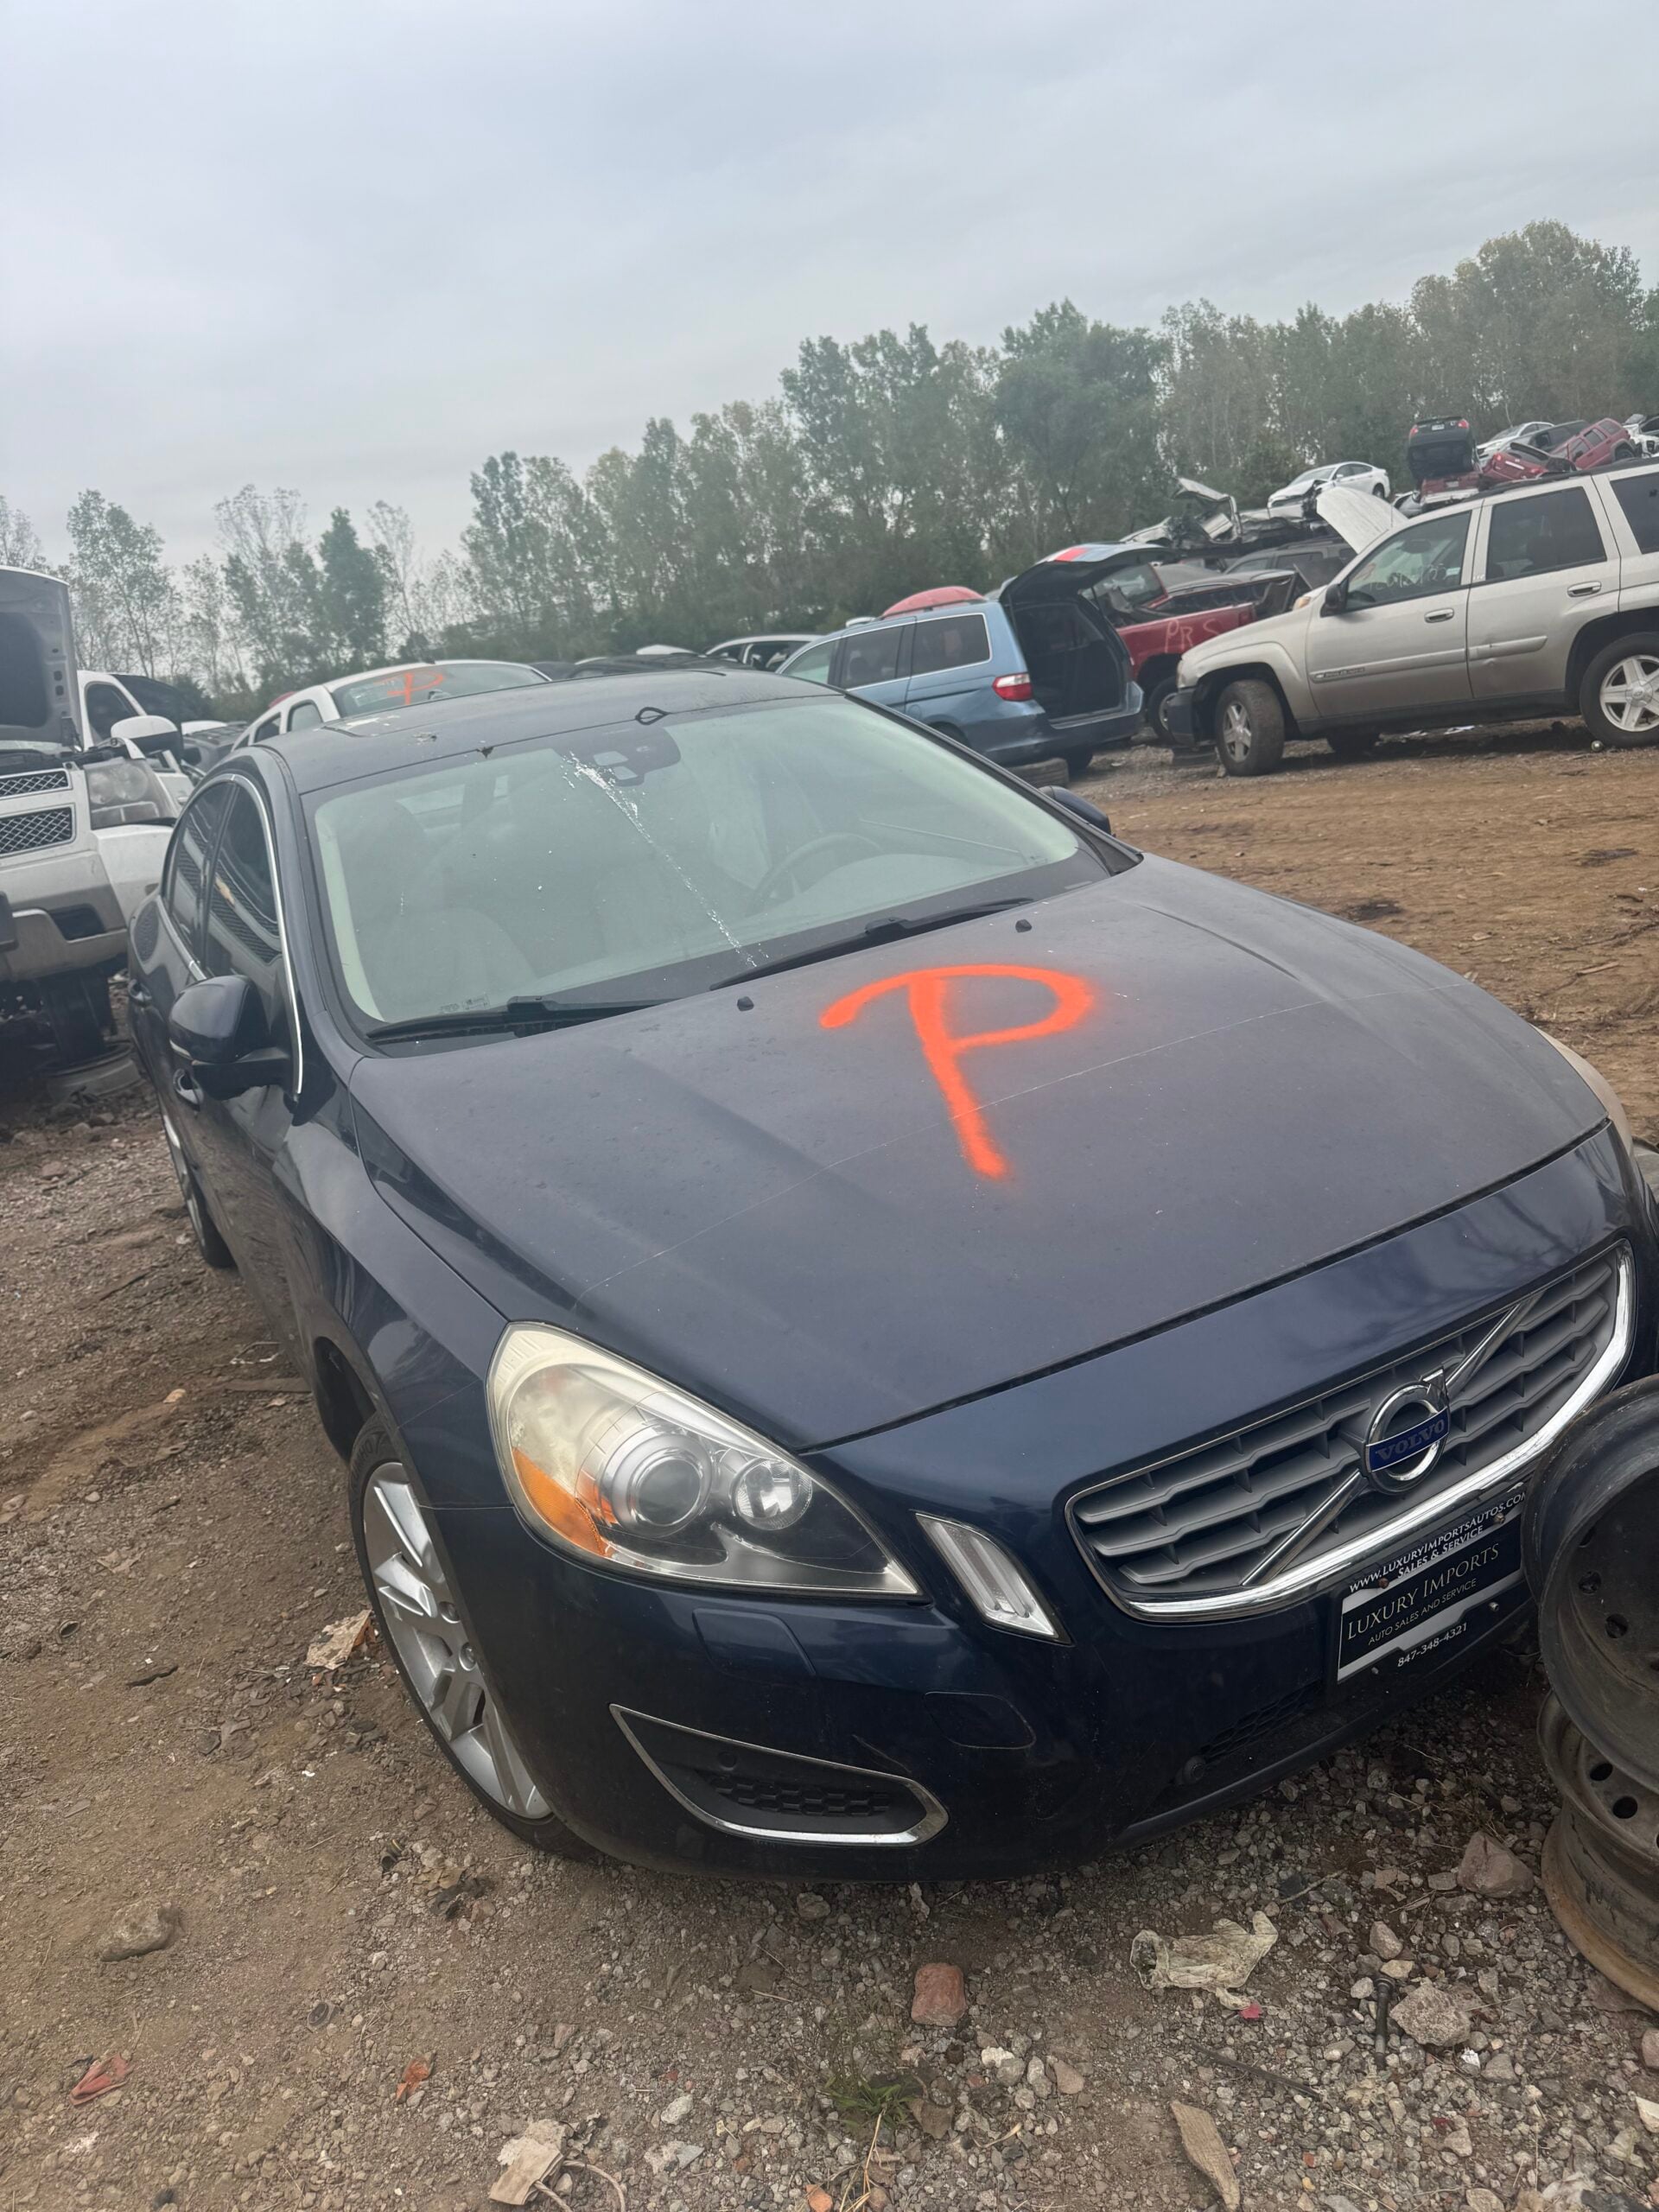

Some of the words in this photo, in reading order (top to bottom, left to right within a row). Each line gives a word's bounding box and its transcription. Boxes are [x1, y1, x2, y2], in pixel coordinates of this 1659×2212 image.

[820, 963, 1096, 1179] P
[1376, 1419, 1446, 1460] VOLVO
[1397, 1555, 1428, 1580] SALES
[1430, 1548, 1440, 1560] &
[1442, 1525, 1484, 1554] SERVICE
[1348, 1587, 1419, 1640] LUXURY
[1423, 1542, 1499, 1598] IMPORTS
[1368, 1626, 1393, 1646] AUTO
[1394, 1611, 1420, 1630] SALES
[1421, 1599, 1440, 1616] AND
[1441, 1578, 1477, 1604] SERVICE
[1397, 1622, 1467, 1668] 847-348-4321
